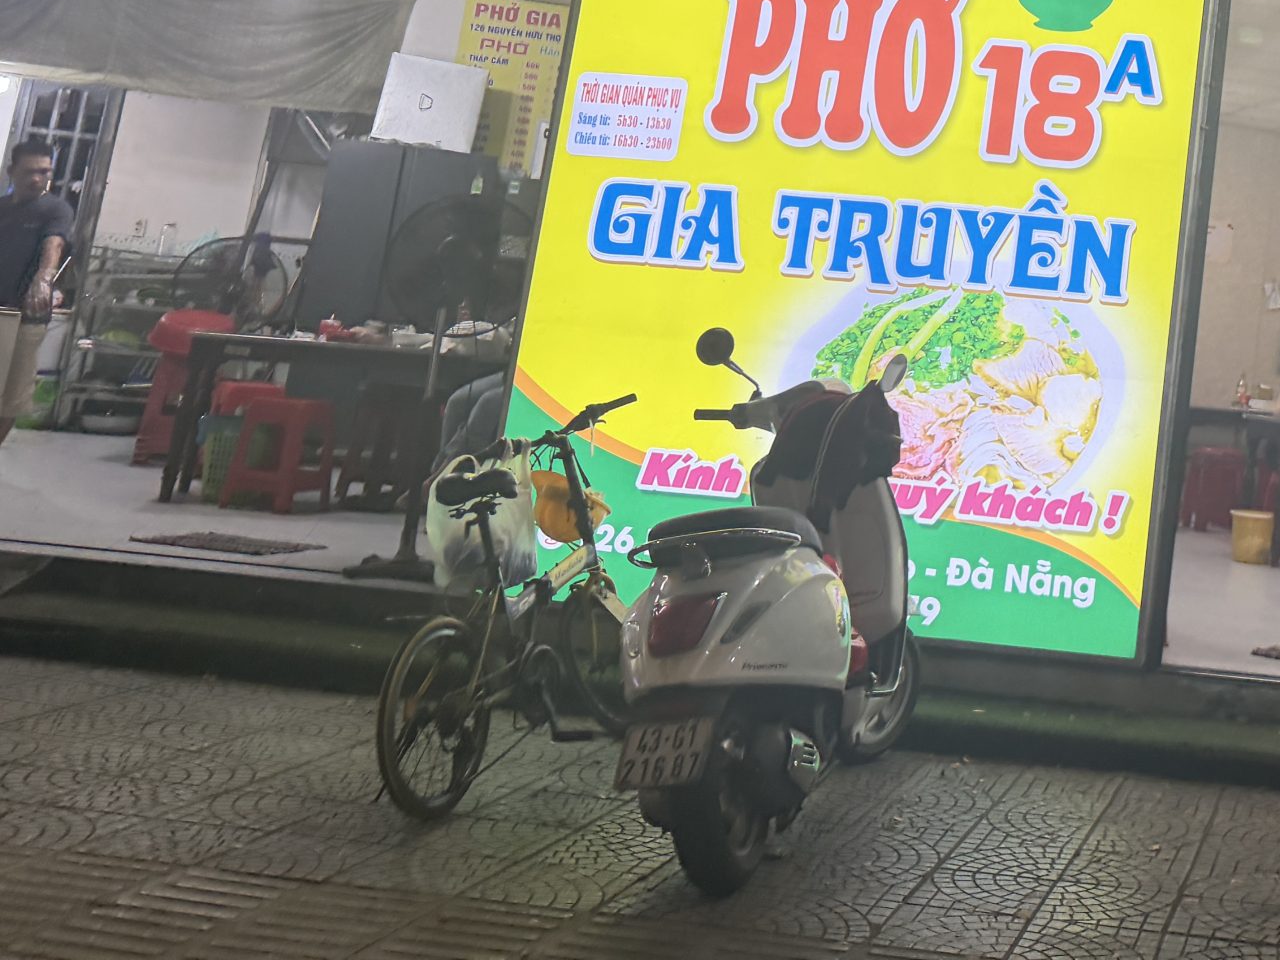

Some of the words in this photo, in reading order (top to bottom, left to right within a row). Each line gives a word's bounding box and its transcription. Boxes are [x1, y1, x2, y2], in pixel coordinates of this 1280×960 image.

[474, 2, 520, 22] PHỞ
[526, 10, 561, 29] GIA
[581, 78, 600, 103] THỜI
[600, 83, 622, 104] GIAN
[622, 82, 646, 107] QUÁN
[646, 86, 669, 112] PHỤC
[669, 88, 682, 113] VỤ
[577, 112, 599, 127] Sáng
[617, 115, 639, 128] 5h30
[646, 116, 672, 130] 13h30
[613, 134, 639, 148] 16h30
[646, 136, 673, 150] 23h00
[590, 179, 743, 270] GIA
[775, 182, 1136, 302] TRUYỀN
[638, 450, 745, 495] Kính
[890, 476, 955, 520] uý
[957, 481, 1095, 529] khách
[946, 556, 994, 590] Đà
[1003, 559, 1097, 608] Nẵng
